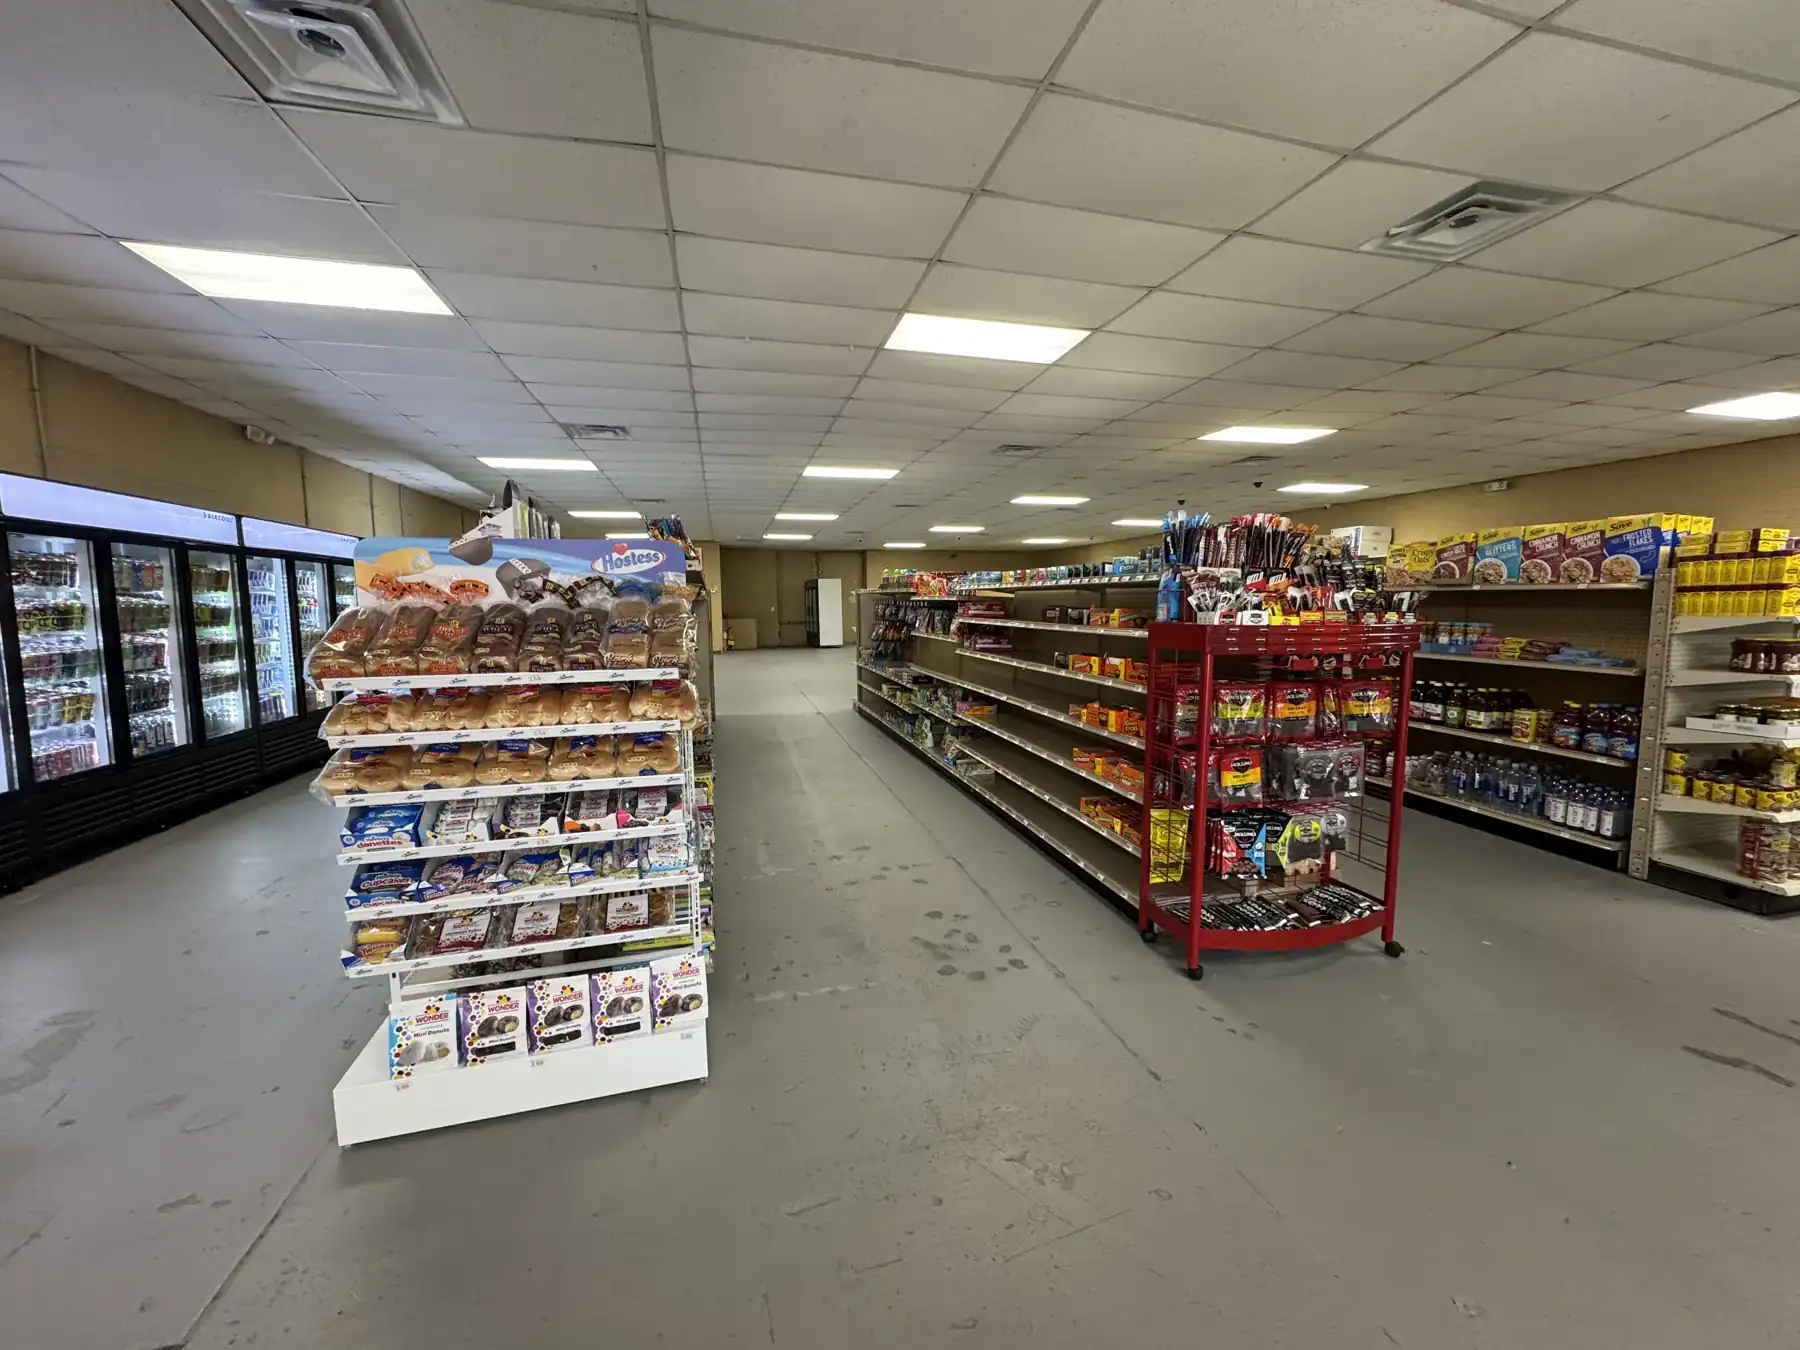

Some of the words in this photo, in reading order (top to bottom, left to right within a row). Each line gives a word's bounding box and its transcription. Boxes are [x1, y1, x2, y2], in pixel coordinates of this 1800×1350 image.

[1622, 528, 1653, 542] FROSTED
[1628, 536, 1654, 549] FLAKES
[602, 551, 662, 573] Hostess
[672, 968, 700, 978] WONDER
[614, 984, 644, 994] WONDER
[552, 992, 583, 1004] WONDER
[488, 1002, 520, 1013] WONDER
[415, 1012, 449, 1024] WONDER
[427, 1028, 450, 1036] Donuts
